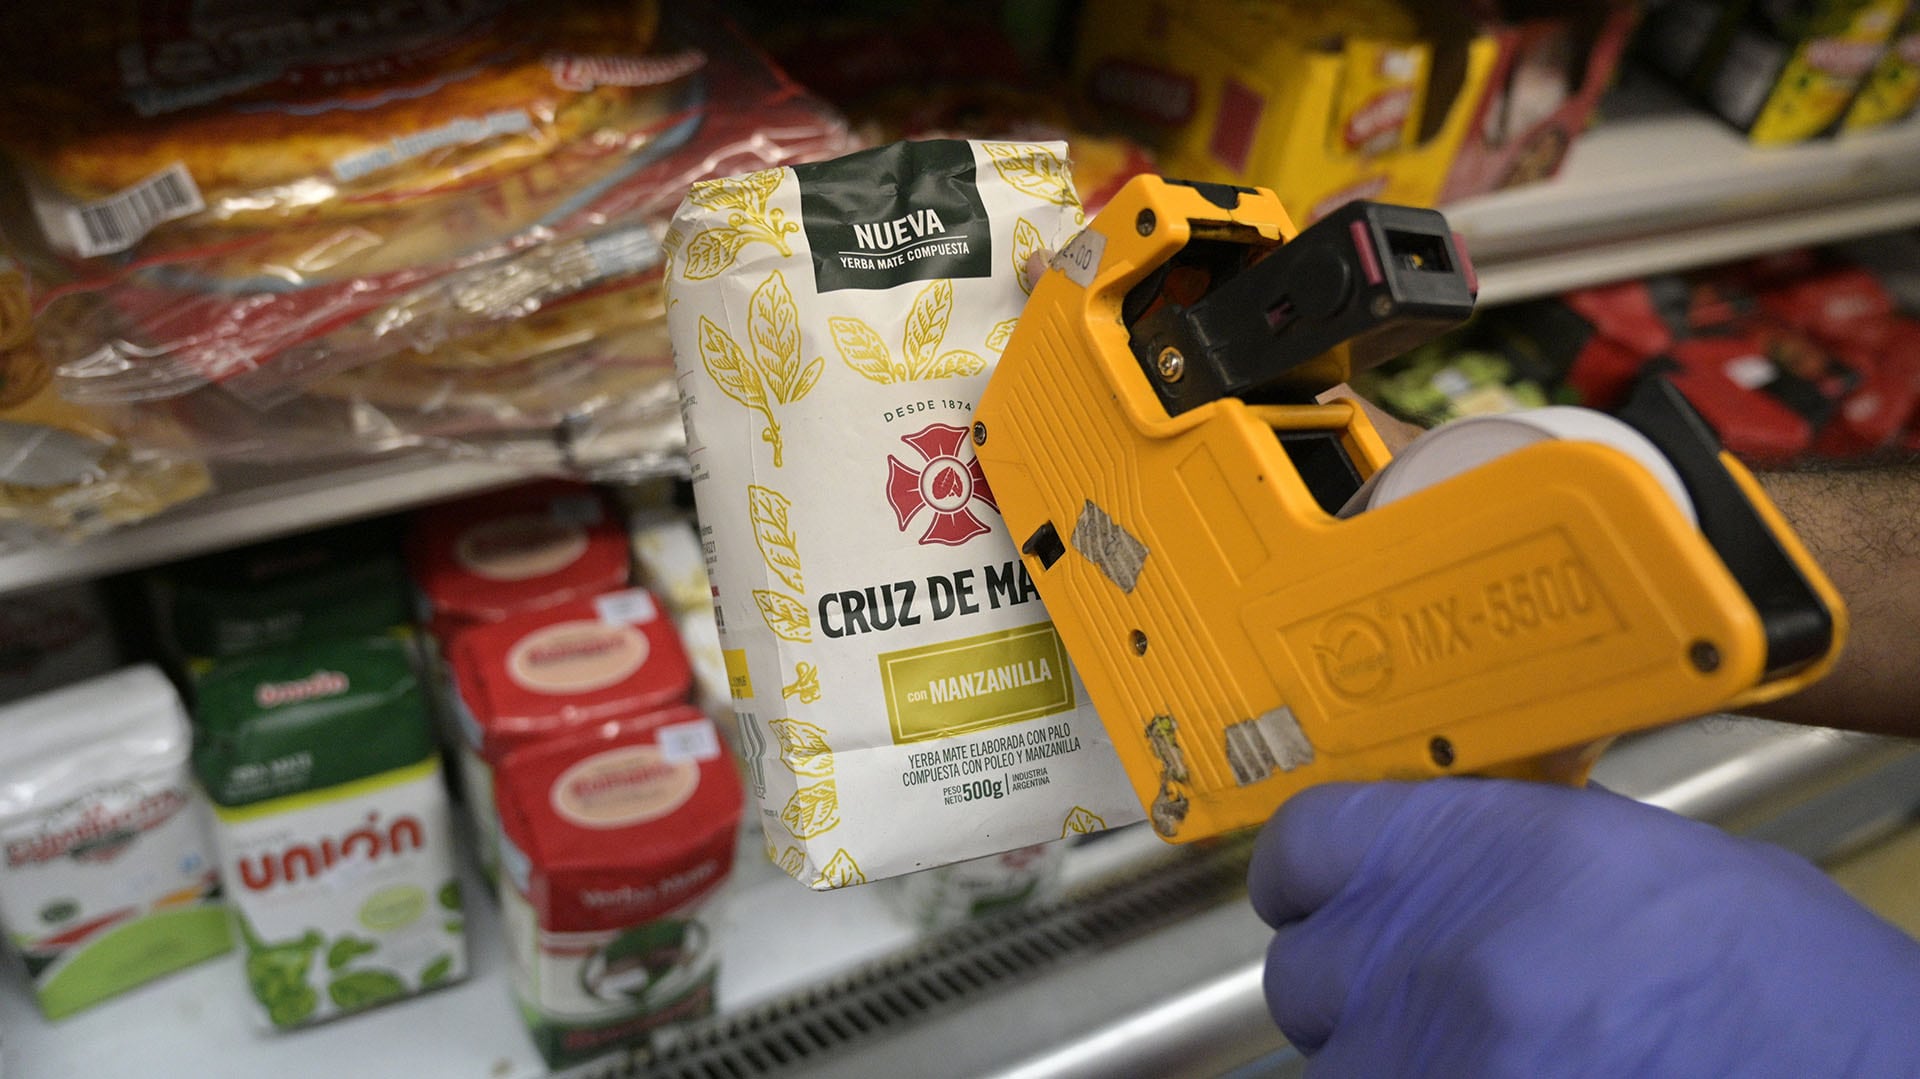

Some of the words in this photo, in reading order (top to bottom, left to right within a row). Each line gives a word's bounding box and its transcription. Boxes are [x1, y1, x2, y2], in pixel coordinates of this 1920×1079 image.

[853, 208, 945, 249] NUEVA
[840, 256, 875, 270] YERBA
[877, 254, 905, 270] MATE
[907, 242, 969, 261] COMPUESTA
[883, 400, 935, 422] DESDE
[942, 400, 971, 411] 1874
[818, 580, 921, 638] CRUZ
[926, 569, 979, 621] DE
[983, 559, 1041, 609] MA
[1401, 556, 1593, 666] MX-5500
[907, 689, 928, 704] con
[929, 658, 1053, 704] MANZANILLA
[902, 763, 961, 787] COMPUESTA
[962, 758, 983, 775] CON
[984, 752, 1015, 771] POLEO
[1017, 750, 1023, 764] Y
[1024, 737, 1081, 763] MANZANILLA
[908, 751, 941, 769] YERBA
[942, 745, 968, 763] MATE
[971, 734, 1026, 757] ELABORADA
[1027, 729, 1047, 745] CON
[1048, 722, 1071, 740] PALO
[943, 785, 962, 796] PESO
[962, 778, 1004, 802] 500g
[1012, 767, 1048, 782] INDUSTRIA
[944, 794, 963, 805] NETO
[1012, 776, 1050, 792] ARGENTINA
